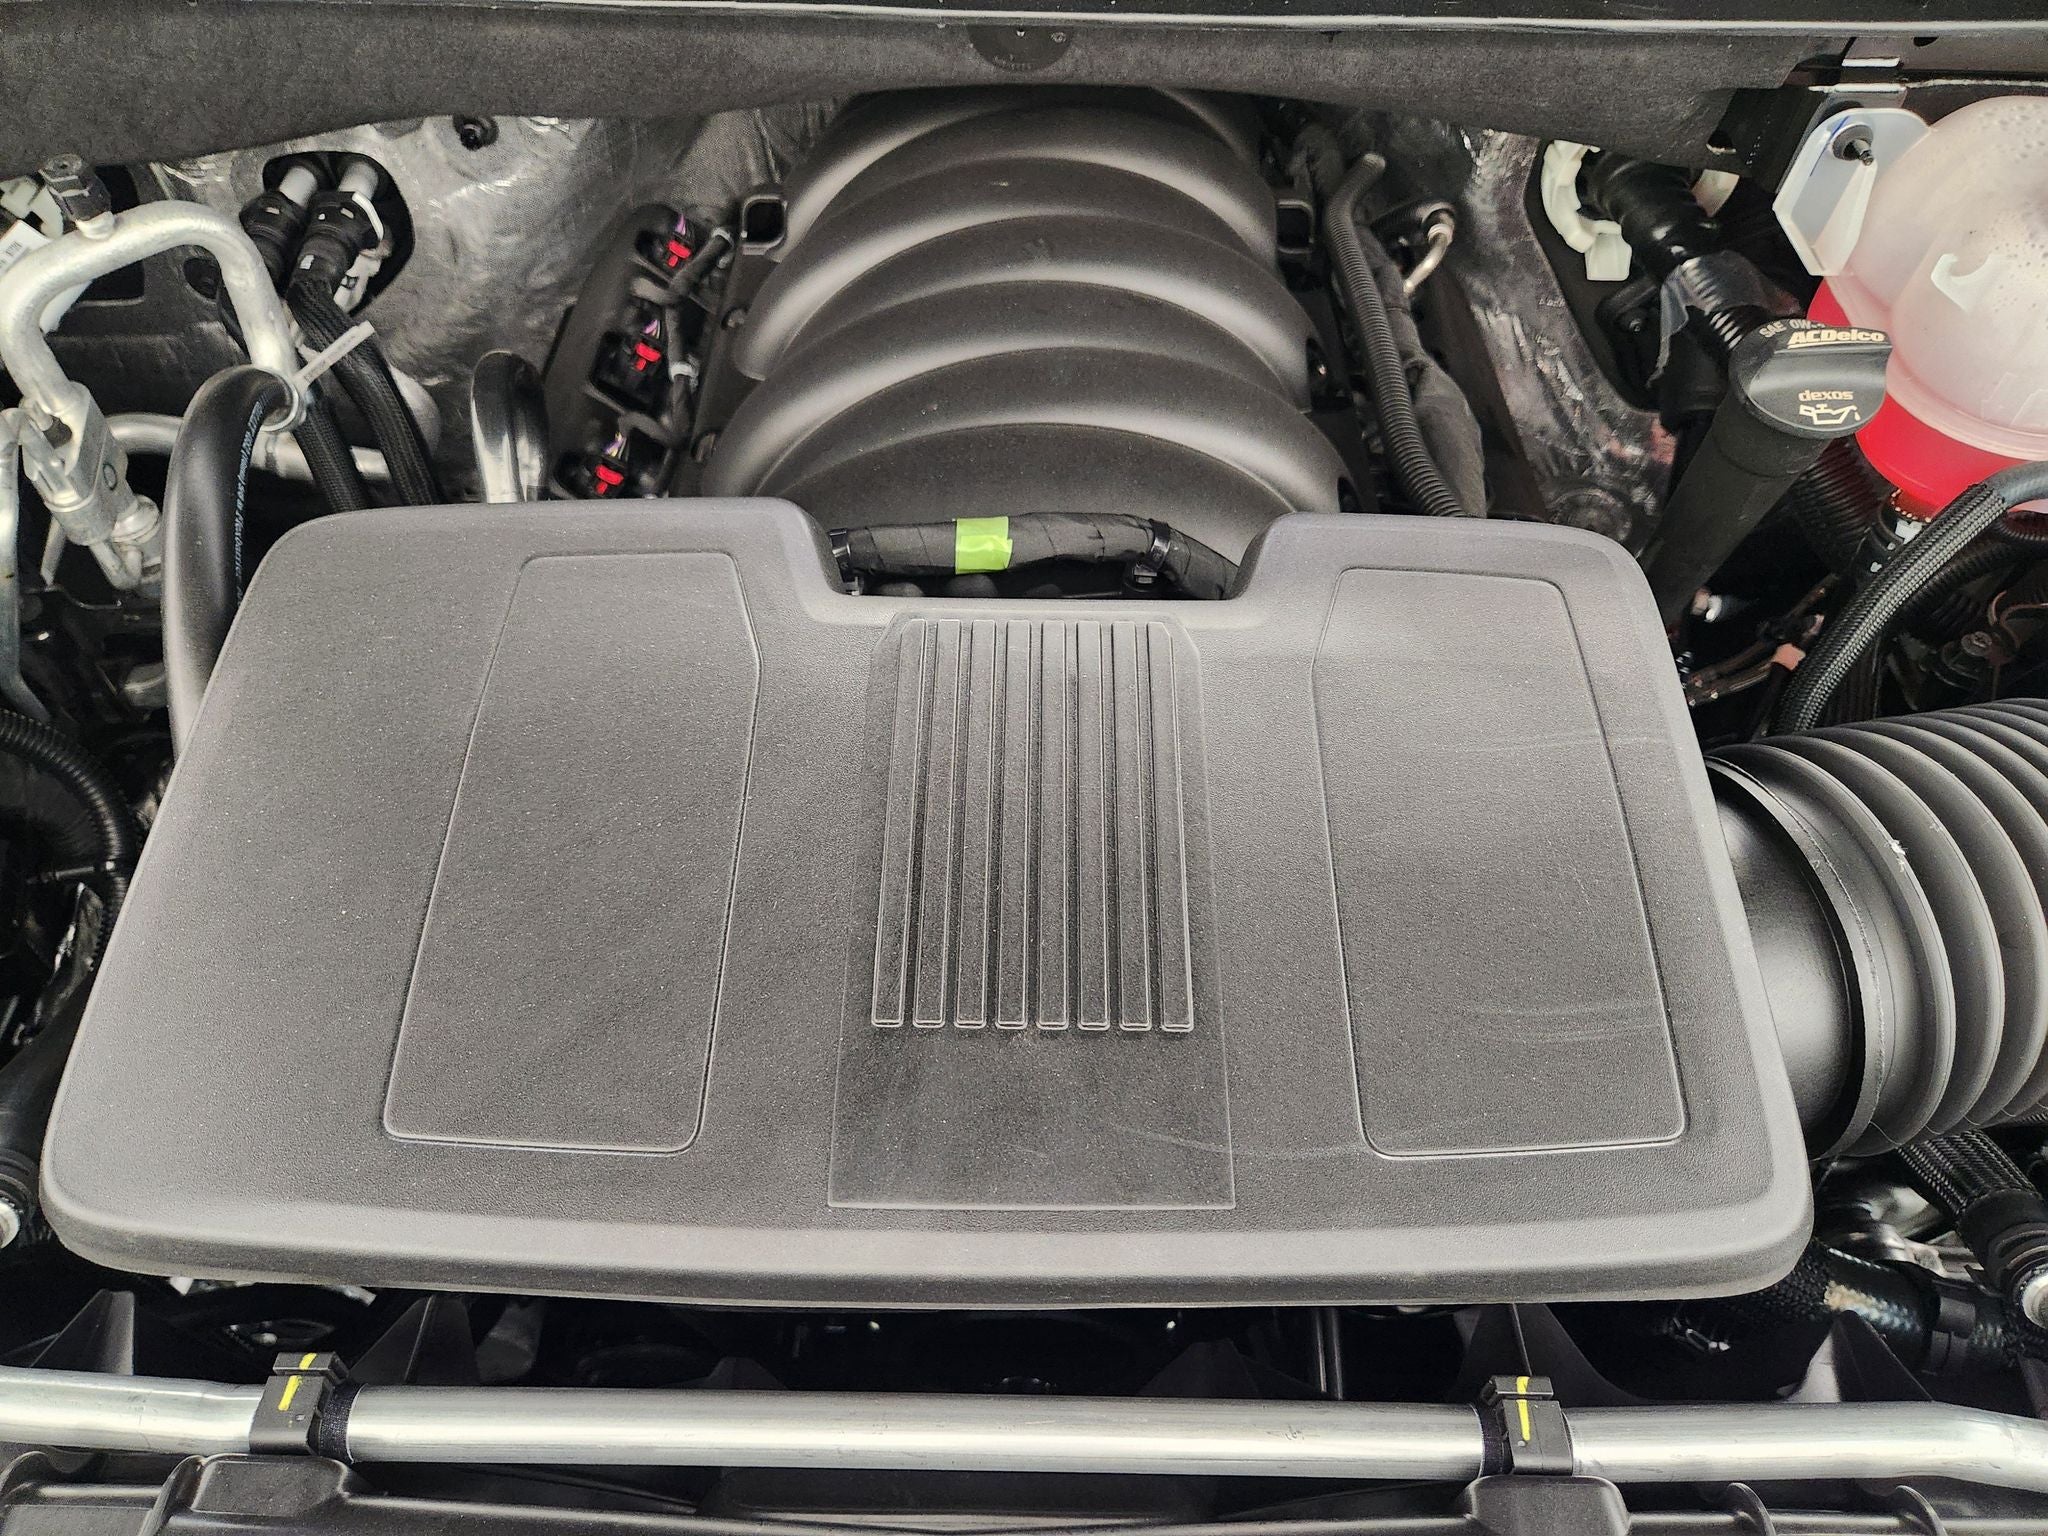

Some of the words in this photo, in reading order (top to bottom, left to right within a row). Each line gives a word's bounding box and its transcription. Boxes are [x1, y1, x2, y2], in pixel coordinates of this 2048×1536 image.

[1759, 321, 1787, 338] SAE
[1787, 329, 1885, 346] ACDelco
[1798, 390, 1854, 402] dexos
